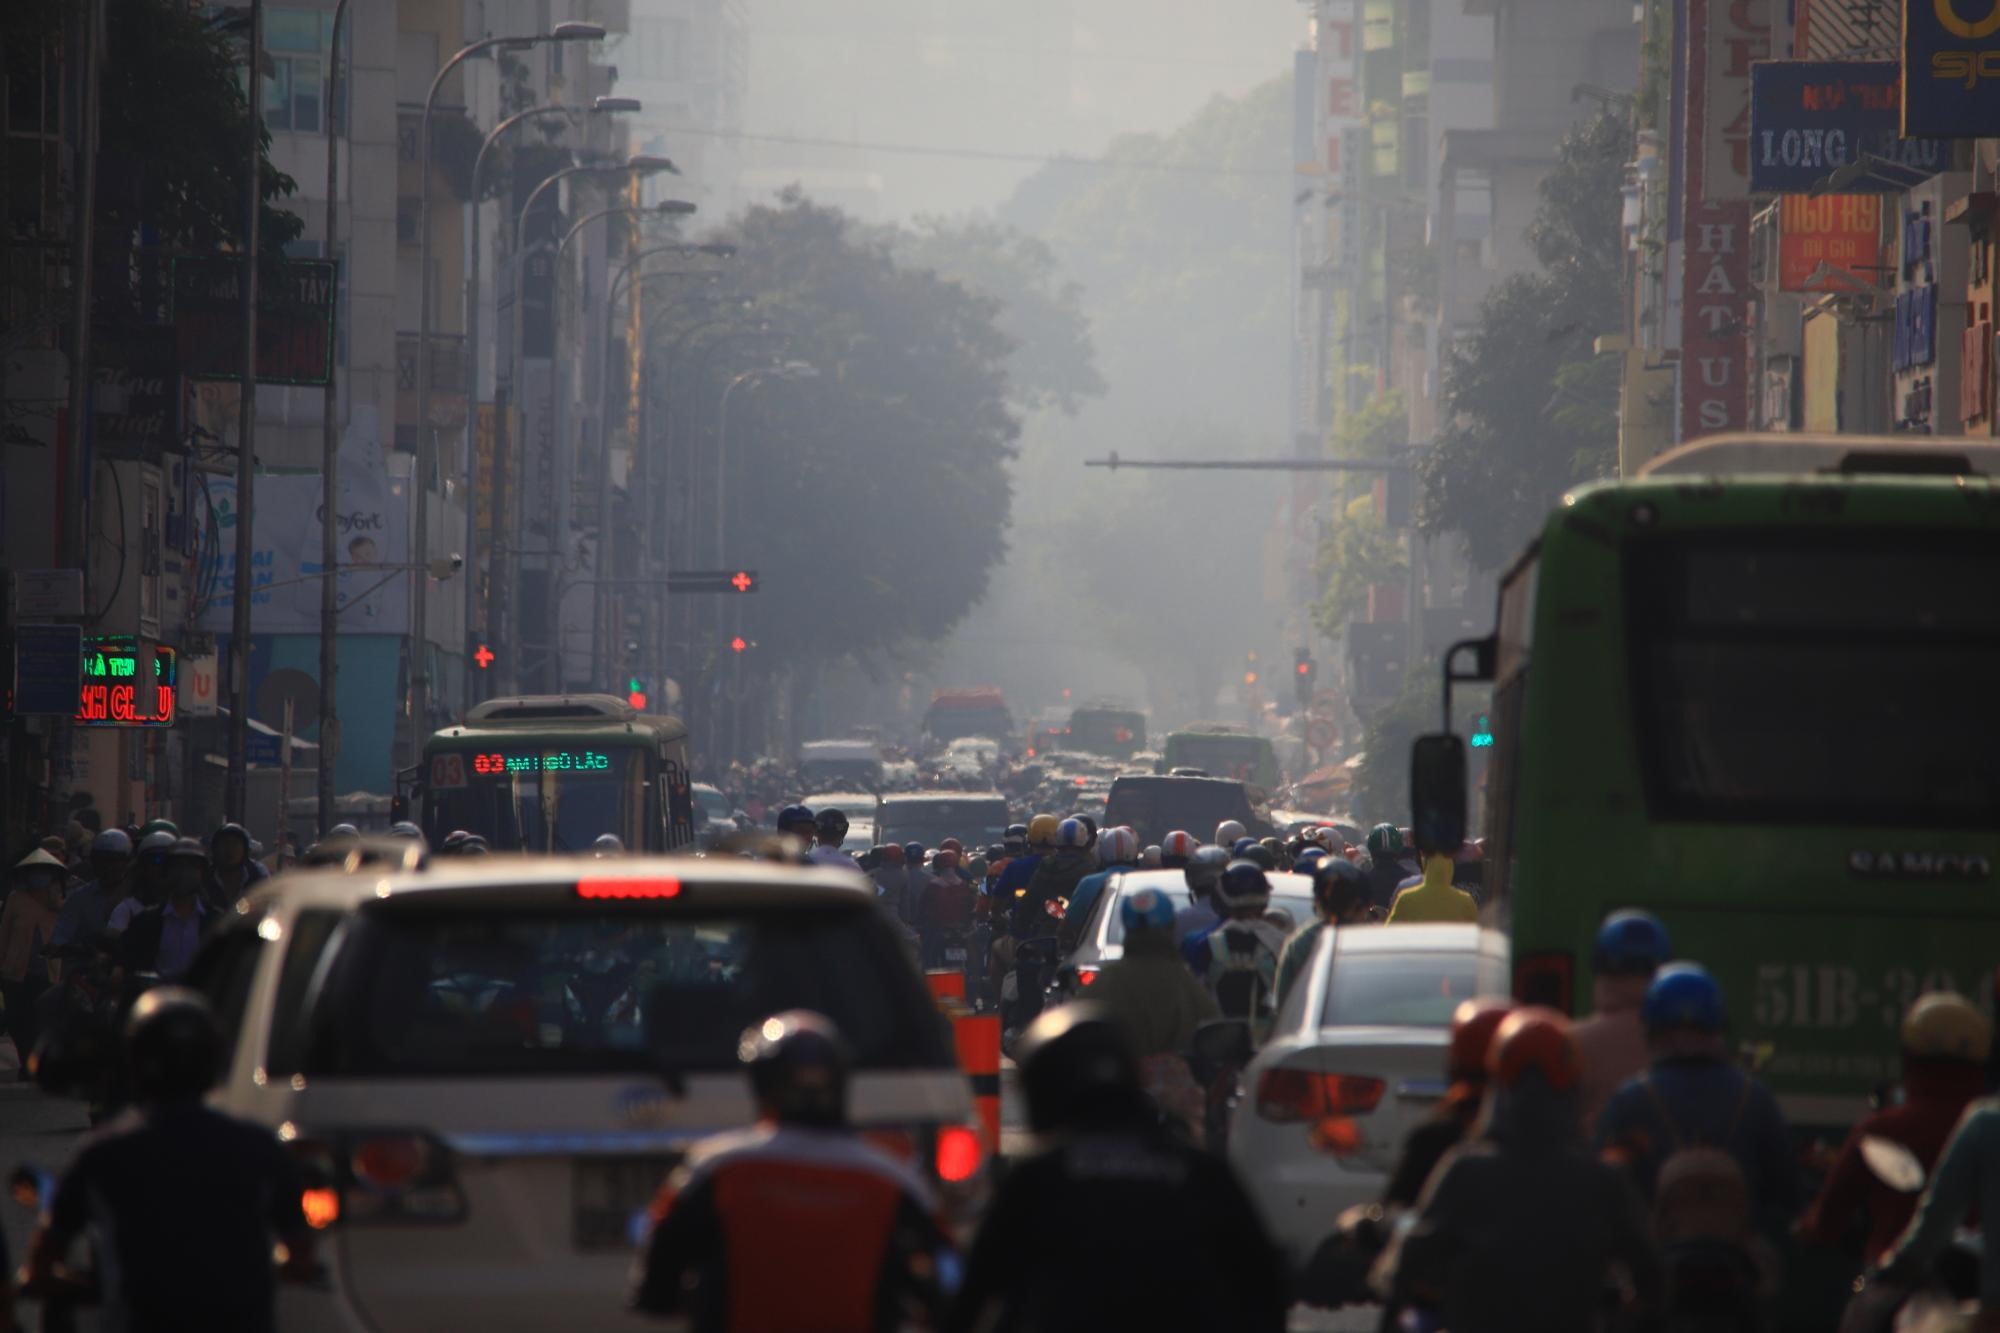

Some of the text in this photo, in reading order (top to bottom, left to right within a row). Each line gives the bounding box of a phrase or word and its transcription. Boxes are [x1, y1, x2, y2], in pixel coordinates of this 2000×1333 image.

[1761, 128, 1847, 168] LONG
[1697, 200, 1736, 342] HÁT
[111, 684, 171, 722] CHU
[433, 757, 463, 787] 03
[474, 753, 505, 774] 03
